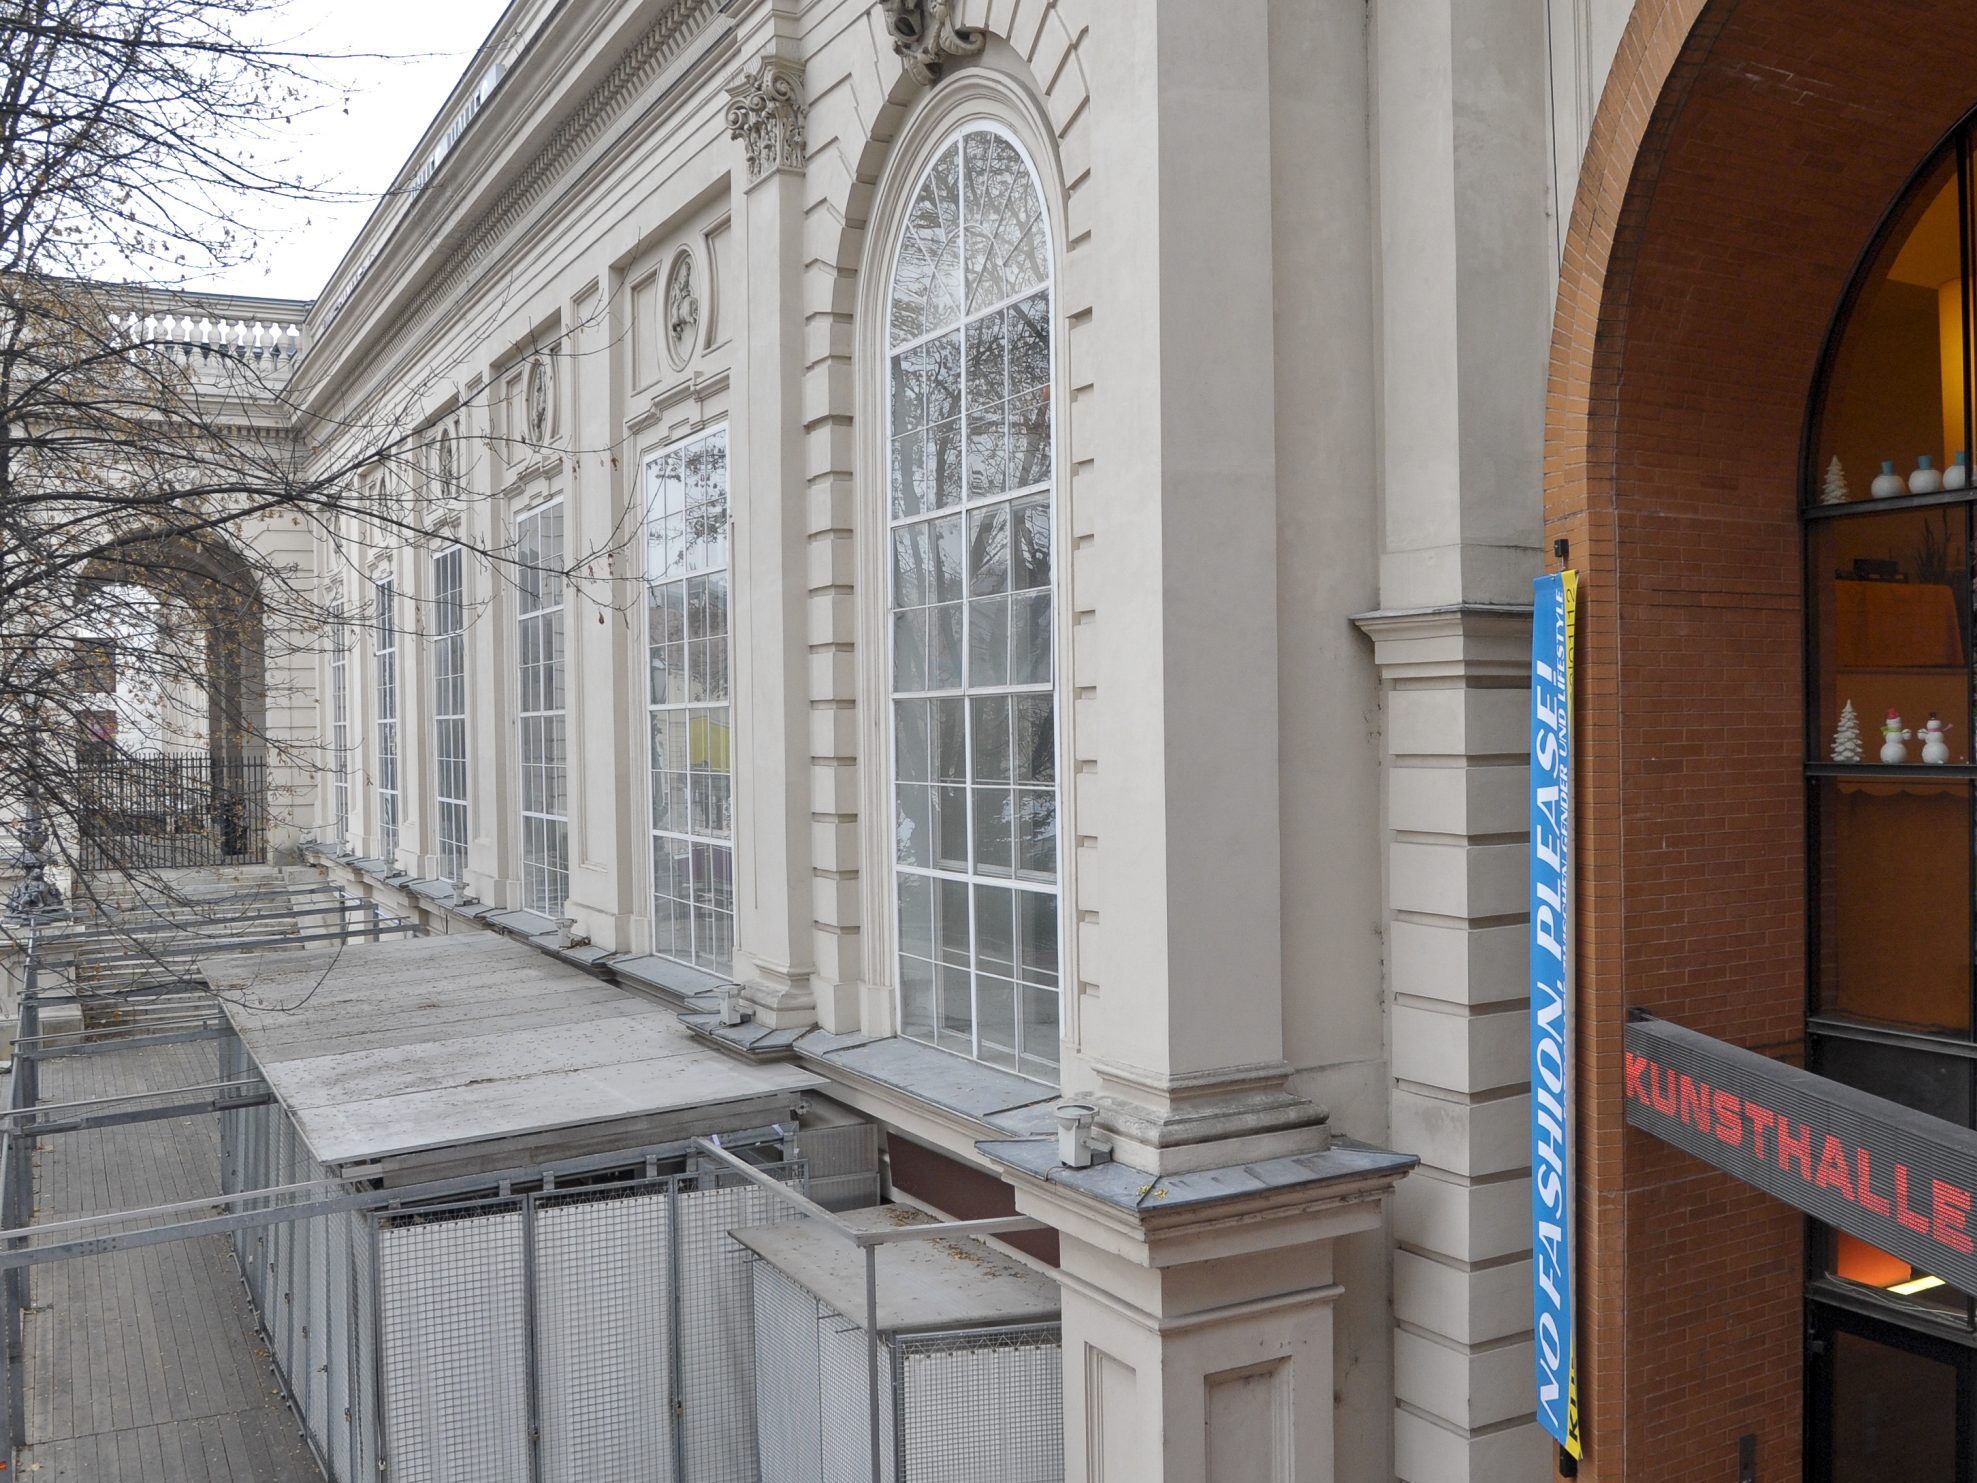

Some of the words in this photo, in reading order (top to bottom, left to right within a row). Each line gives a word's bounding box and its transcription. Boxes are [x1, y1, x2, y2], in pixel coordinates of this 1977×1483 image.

[1555, 588, 1566, 703] LIFESTYLE
[1558, 709, 1568, 757] UND
[1536, 660, 1562, 962] PLEASE!
[1560, 764, 1568, 852] GENDER
[1625, 1051, 1975, 1256] KUNSTHALLE
[1539, 1312, 1560, 1429] NO
